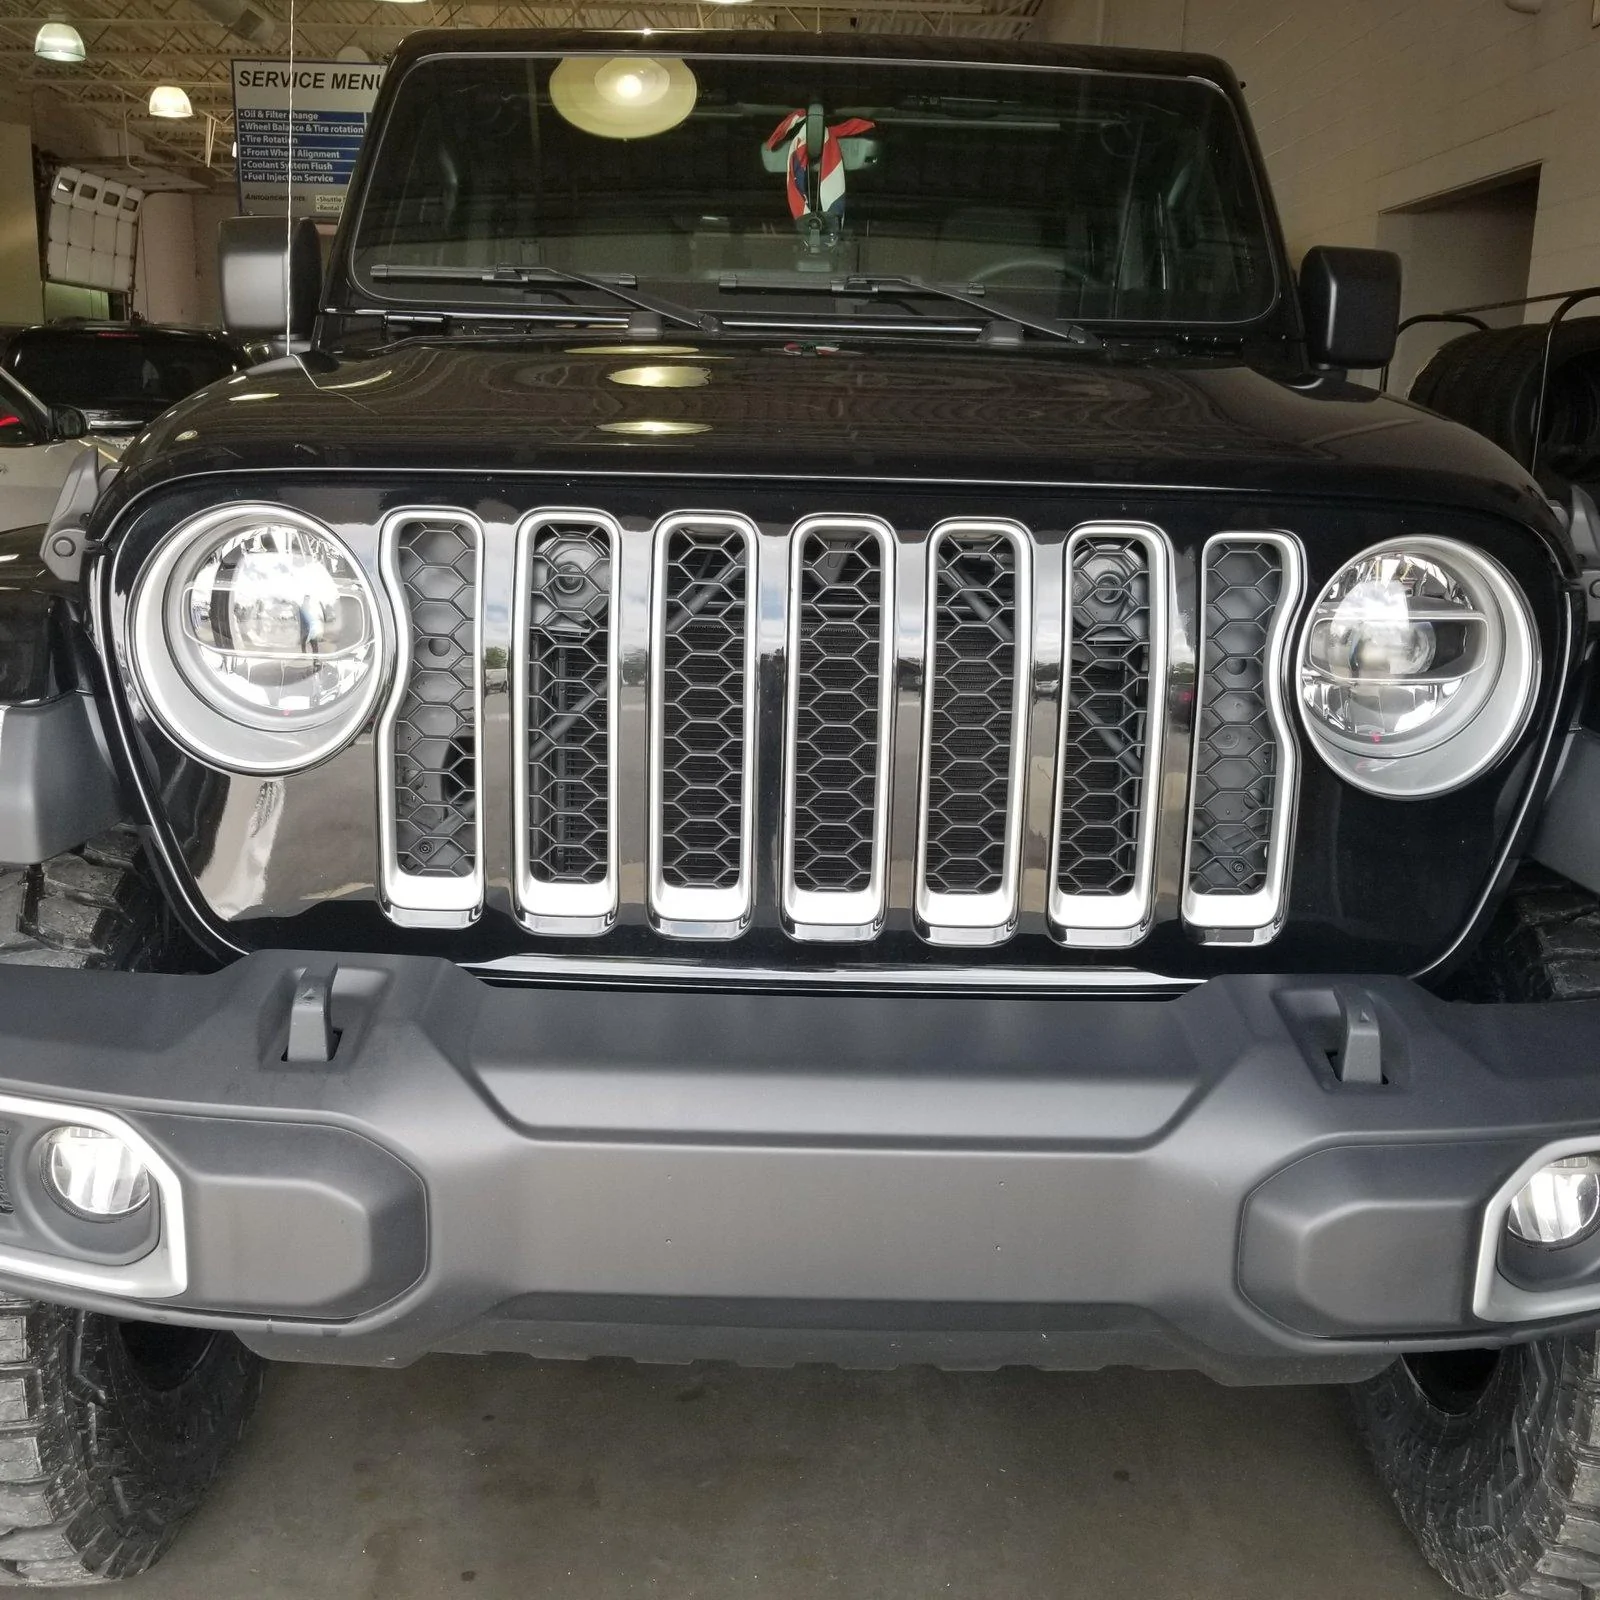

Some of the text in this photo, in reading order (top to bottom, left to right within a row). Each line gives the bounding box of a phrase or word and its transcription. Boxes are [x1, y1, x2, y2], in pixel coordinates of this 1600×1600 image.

[239, 70, 325, 89] SERVICE
[244, 110, 319, 121] Oil & Filter hange
[245, 122, 271, 131] Wheel
[305, 124, 312, 132] &
[313, 125, 330, 133] Tire
[330, 125, 364, 134] rotation
[245, 134, 299, 144] Tire Rotatin
[246, 148, 340, 160] Front Whel Alignment
[247, 160, 333, 171] Coolant Sytem Flush
[248, 172, 334, 183] Fuel Injecton Service
